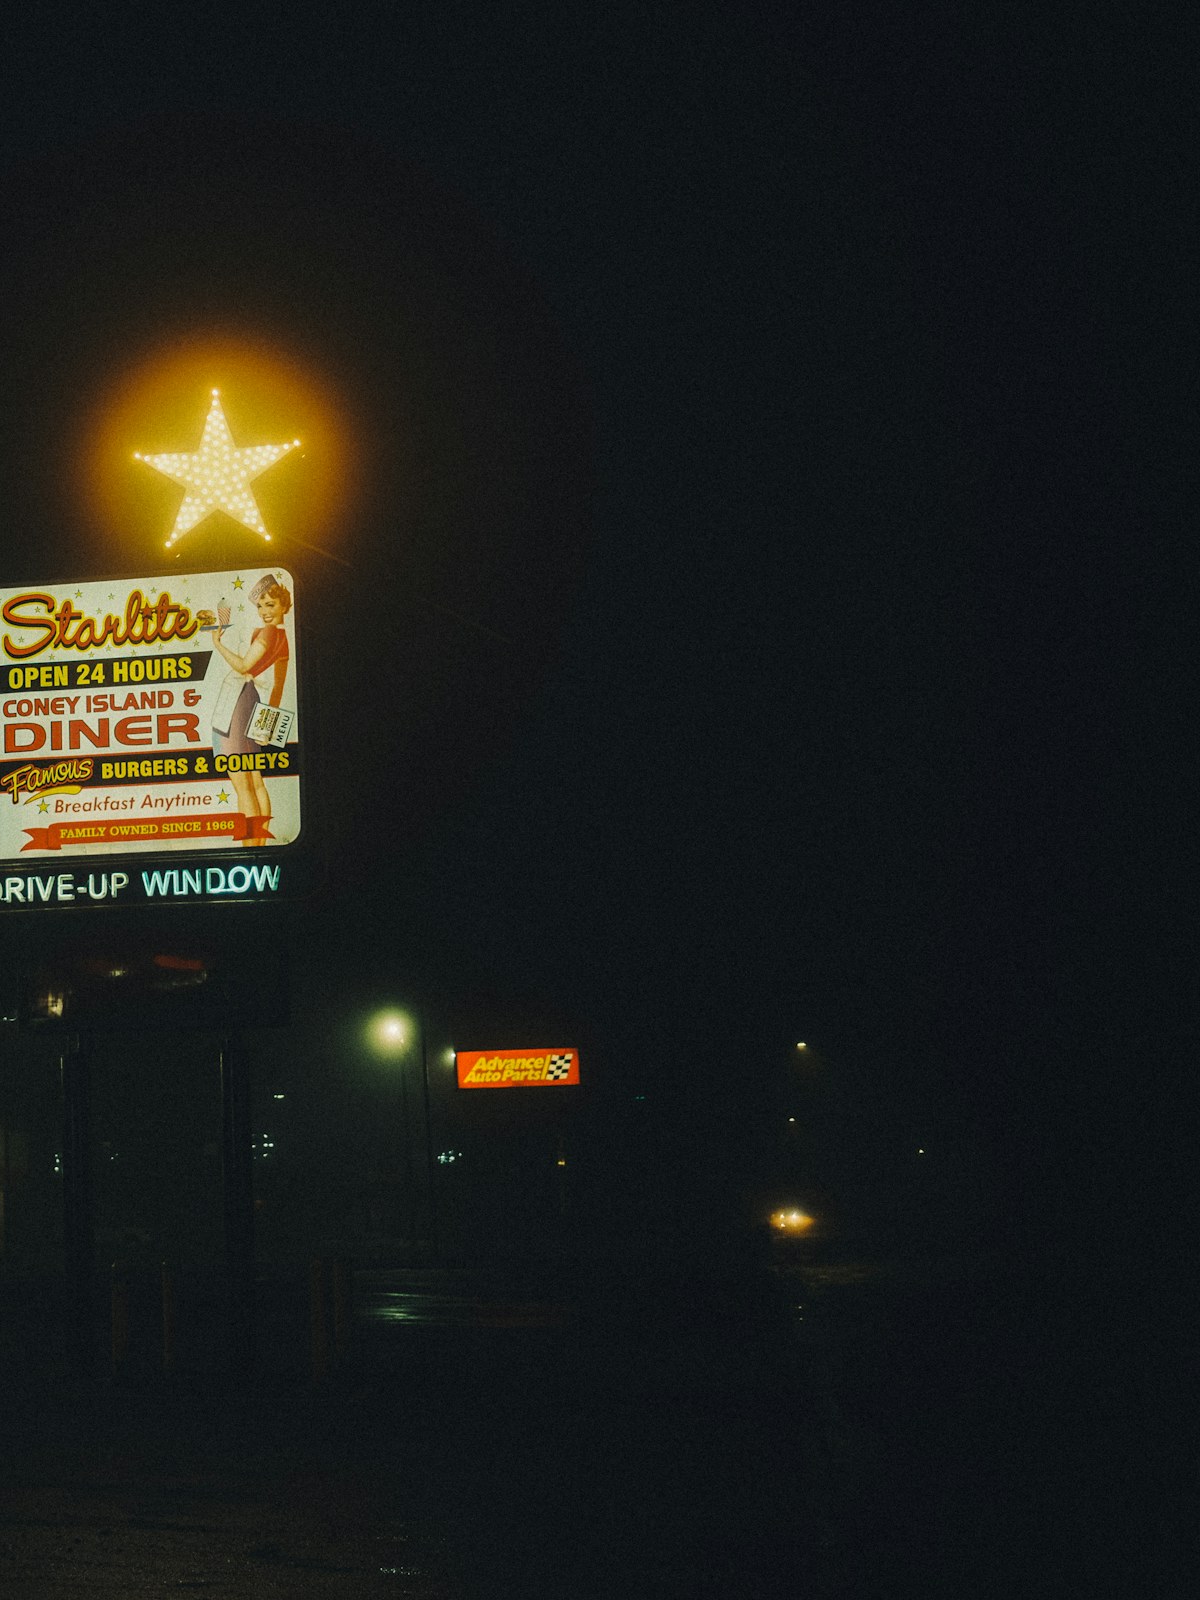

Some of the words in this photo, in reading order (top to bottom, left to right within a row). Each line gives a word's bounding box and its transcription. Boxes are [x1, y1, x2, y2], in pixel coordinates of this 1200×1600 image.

[2, 591, 199, 659] Starlite
[8, 665, 69, 689] OPEN
[76, 663, 106, 685] 24
[113, 657, 192, 683] HOURS
[3, 697, 81, 718] CONEY
[86, 690, 174, 713] ISLAND
[183, 689, 202, 707] &
[4, 713, 201, 753] DINER
[276, 714, 290, 743] MENU
[1, 759, 94, 805] Famous
[101, 758, 189, 779] BURGERS
[194, 757, 209, 774] &
[214, 752, 290, 773] CONEYS
[54, 796, 136, 814] Breakfast
[140, 792, 212, 812] Anytime
[60, 827, 106, 839] FAMILY
[109, 825, 159, 837] OWNED
[162, 822, 202, 834] SINCE
[206, 820, 235, 832] 1966
[141, 864, 282, 897] WINDOW
[463, 1070, 501, 1083] Auto
[501, 1068, 541, 1081] Parts
[471, 1056, 544, 1072] Advance
